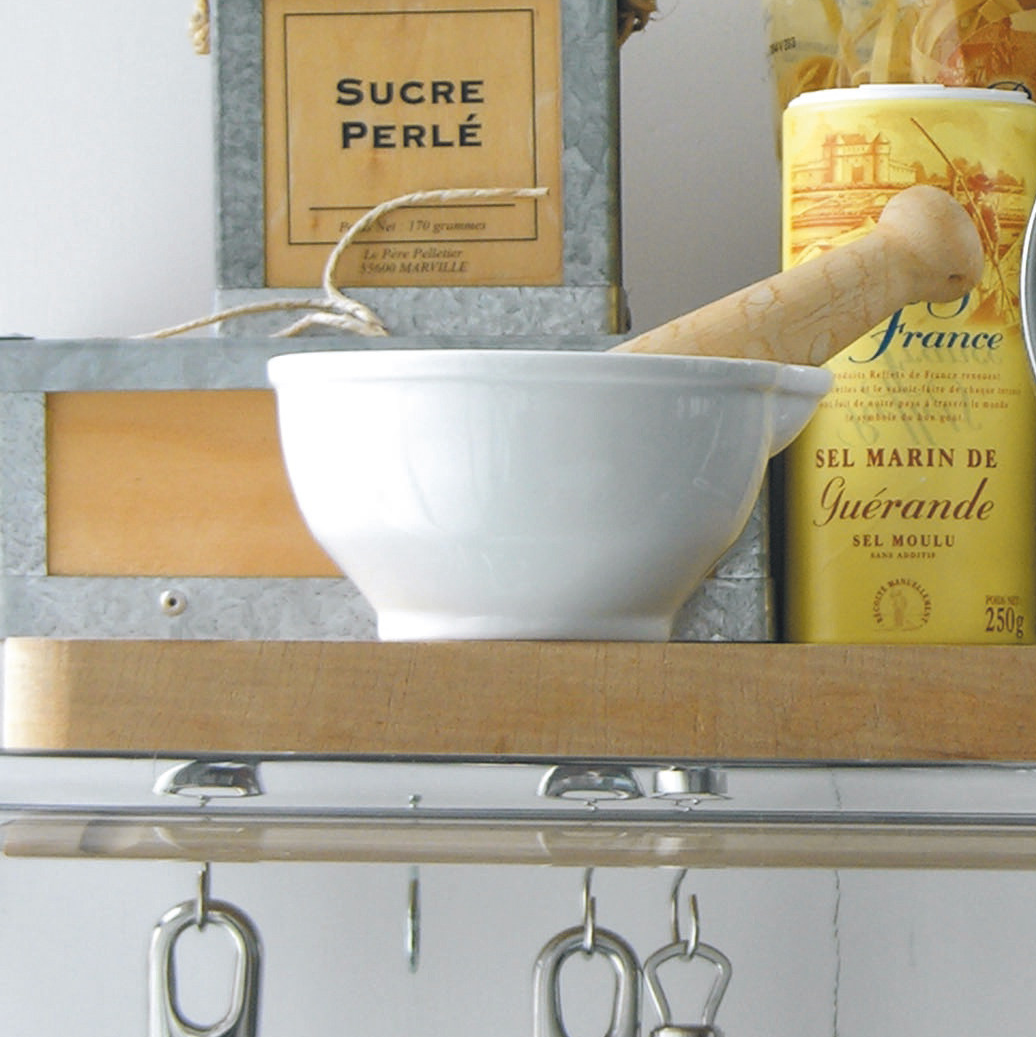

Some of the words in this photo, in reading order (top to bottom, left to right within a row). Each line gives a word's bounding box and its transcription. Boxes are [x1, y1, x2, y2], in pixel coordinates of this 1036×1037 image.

[408, 220, 431, 232] 170
[433, 220, 487, 234] grammes
[412, 247, 464, 260] Pelletier
[399, 261, 468, 274] MARVILLE
[849, 306, 1004, 364] France
[909, 370, 921, 380] de
[923, 370, 958, 380] France
[948, 385, 960, 394] de
[963, 385, 995, 396] chaque
[853, 399, 865, 409] de
[815, 448, 855, 469] SEL
[866, 448, 955, 469] MARIN
[967, 448, 998, 469] DE
[812, 475, 995, 528] Guérande
[852, 534, 884, 548] SEL
[892, 534, 956, 548] MOULU
[985, 606, 1025, 640] 250g
